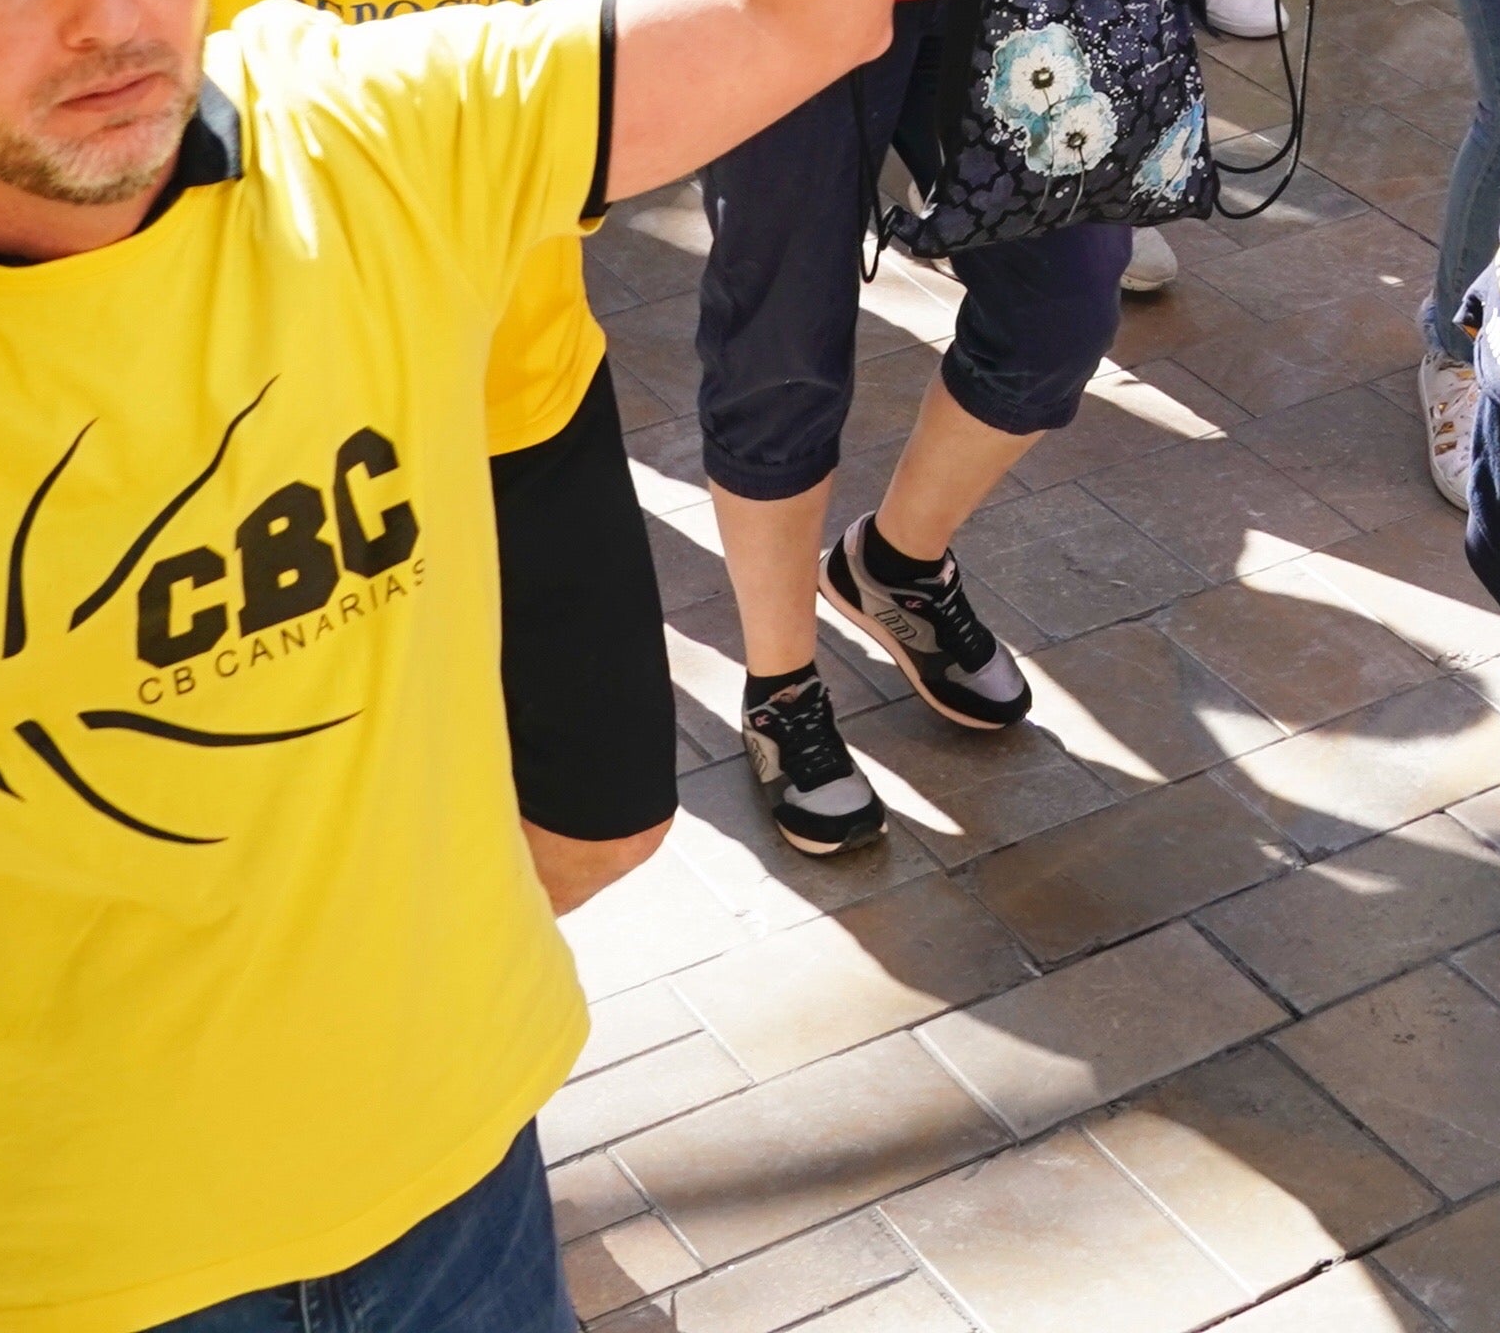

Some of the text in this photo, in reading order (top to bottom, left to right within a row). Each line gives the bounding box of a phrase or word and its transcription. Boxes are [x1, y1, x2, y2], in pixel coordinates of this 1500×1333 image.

[136, 425, 421, 669] CBC
[137, 557, 426, 706] CB CANARIAS
